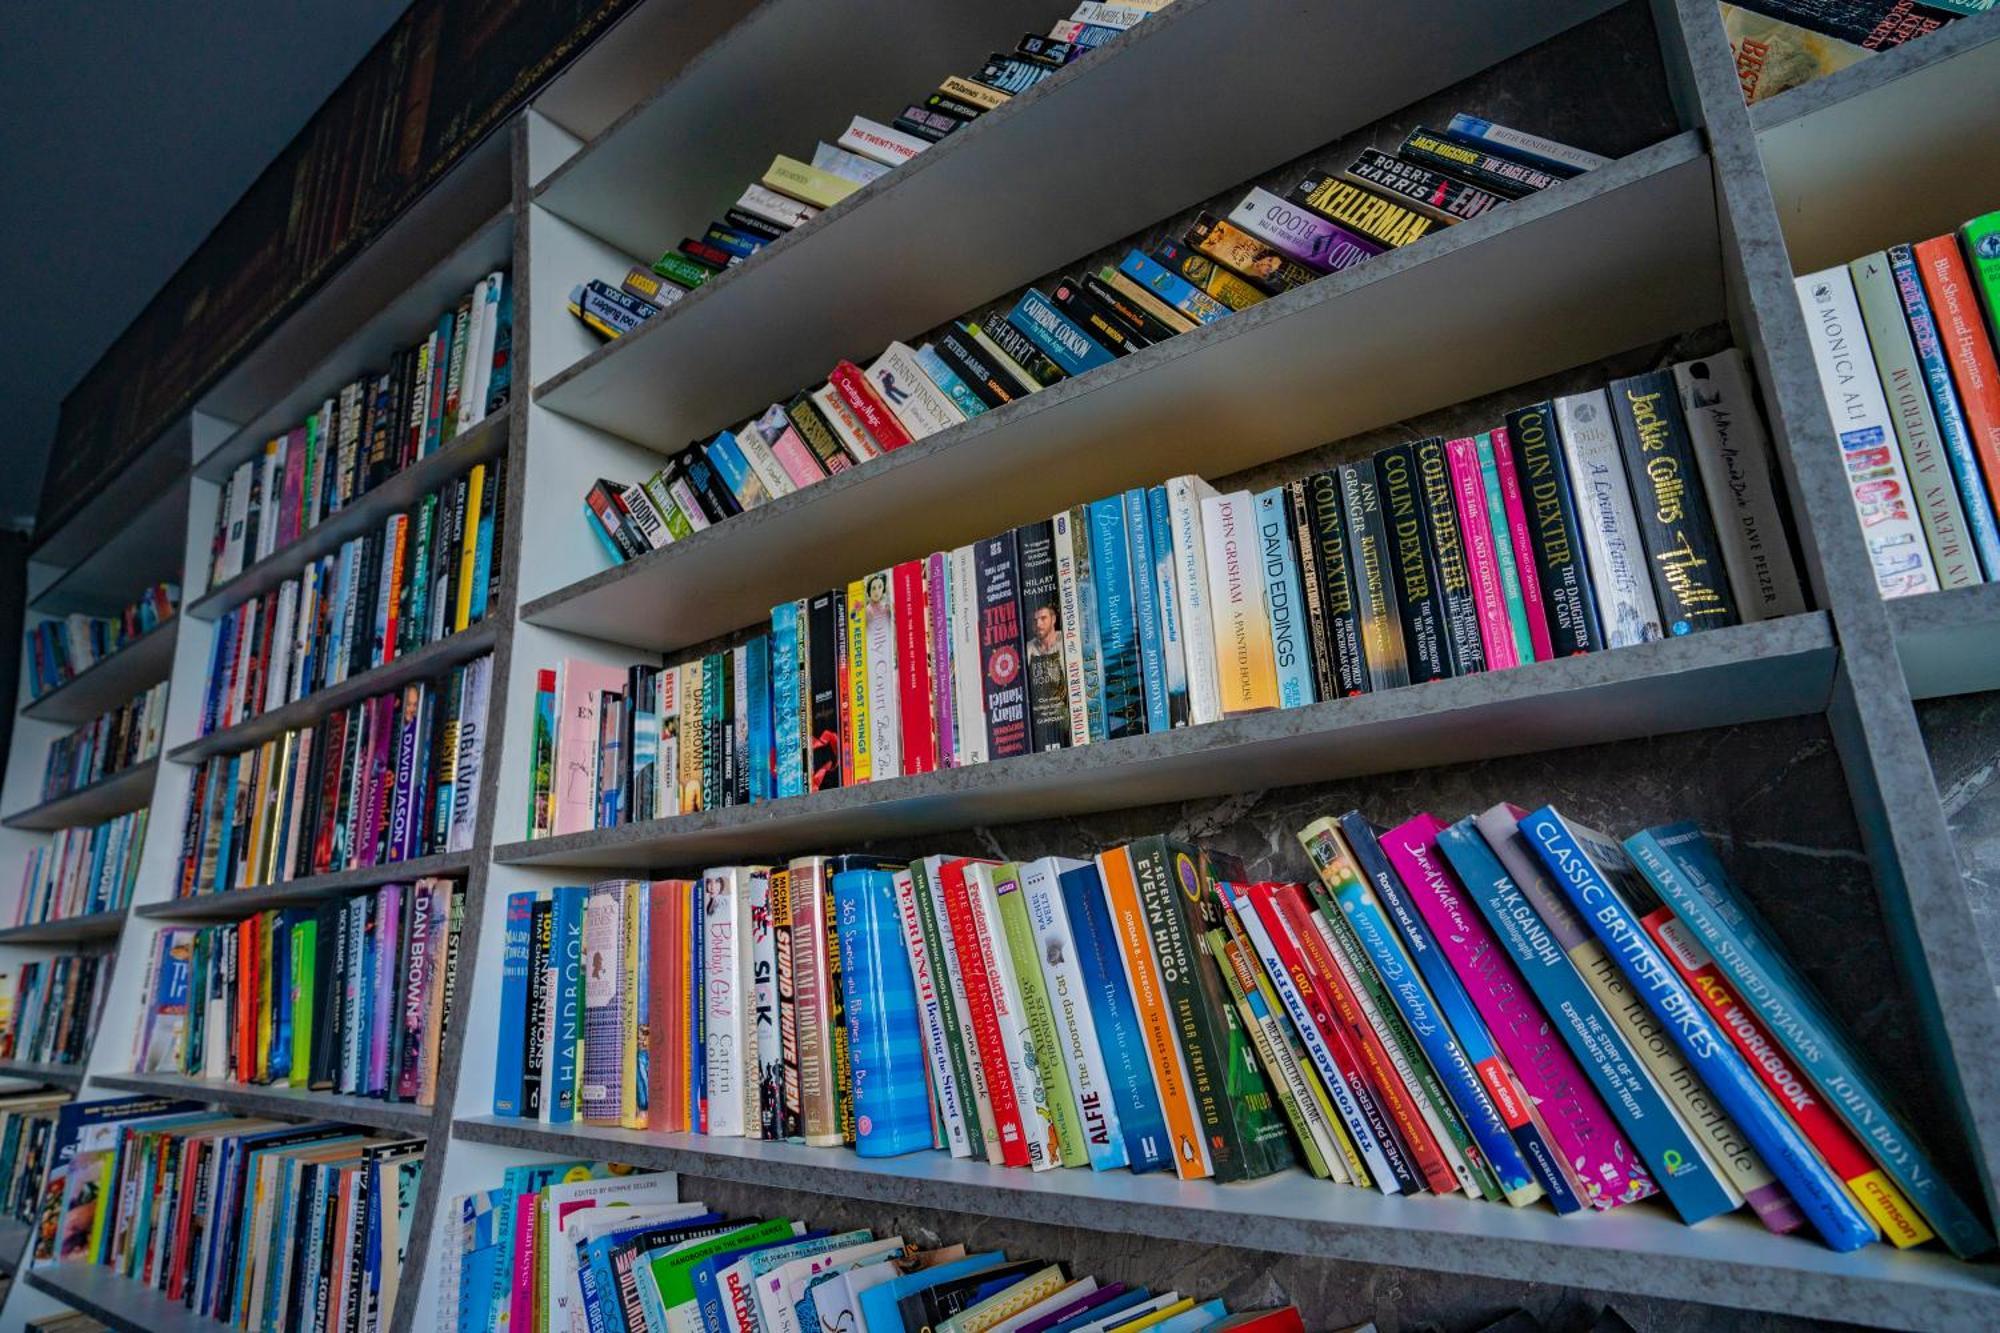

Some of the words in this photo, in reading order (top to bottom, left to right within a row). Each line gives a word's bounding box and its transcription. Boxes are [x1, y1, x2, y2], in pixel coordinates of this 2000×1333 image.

[1374, 155, 1430, 183] ROBERT
[1410, 136, 1437, 153] JACK
[1435, 142, 1480, 165] HIGGINS
[1481, 157, 1500, 172] THE
[1500, 160, 1530, 182] EAGLE
[1528, 170, 1550, 188] HAS
[1356, 164, 1430, 198] HARRIS
[1267, 205, 1318, 240] BLOOD
[1311, 180, 1433, 247] KELLERMAN
[1934, 258, 1948, 282] Blue
[1942, 284, 1958, 318] Shoes
[451, 309, 469, 343] DAN
[1021, 295, 1061, 333] CATHERINE
[1052, 321, 1092, 359] COOKSON
[1953, 318, 1967, 338] and
[443, 343, 465, 401] BROWN
[884, 351, 921, 390] PENNY
[941, 334, 969, 360] PETER
[962, 354, 991, 382] JAMES
[1820, 307, 1856, 384] MONICA
[1843, 391, 1867, 421] ALI
[1959, 335, 1985, 391] Happiness
[407, 382, 427, 428] RYAN
[1891, 367, 1937, 474] AMSTERDAM
[1419, 443, 1446, 510] COLIN
[1627, 389, 1666, 452] Jackie
[1647, 455, 1686, 524] Collins
[1314, 475, 1335, 535] COLIN
[1344, 468, 1365, 534] GRANGER
[1360, 482, 1377, 513] ANN
[1384, 455, 1415, 521] COLIN
[1518, 413, 1548, 477] COLIN
[1533, 480, 1572, 568] DEXTER
[625, 492, 665, 537] KOONTZ
[1218, 501, 1234, 538] JOHN
[1740, 514, 1763, 552] DAVE
[1262, 522, 1284, 577] DAVID
[1397, 521, 1430, 602] DEXTER
[1430, 509, 1466, 593] DEXTER
[1023, 584, 1057, 596] MANTEL
[1026, 575, 1054, 587] HILARY
[1323, 536, 1351, 616] DEXTER
[1476, 559, 1497, 609] FOREVER
[1552, 588, 1565, 600] OF
[1561, 564, 1574, 585] THE
[1750, 552, 1779, 604] PELZER
[1270, 581, 1295, 668] EDDINGS
[1556, 601, 1572, 629] CAIN
[1565, 586, 1590, 649] DAUGHTERS
[1427, 630, 1441, 674] THROUGH
[693, 688, 703, 713] DAN
[703, 663, 713, 714] JAMES
[693, 720, 703, 771] BROWN
[856, 711, 866, 754] THINGS
[398, 733, 413, 783] DAVID
[449, 721, 478, 826] OBLIVION
[703, 719, 713, 810] PATTERSON
[391, 787, 408, 843] JASON
[772, 878, 780, 925] MOORE
[778, 876, 788, 925] MICHAEL
[897, 877, 923, 938] PETER
[954, 881, 967, 902] THE
[967, 882, 989, 935] Freedom
[1376, 872, 1399, 907] Romeo
[1403, 840, 1434, 887] David
[1430, 882, 1471, 935] Walliams
[412, 896, 428, 938] DAN
[542, 912, 551, 949] 1001
[842, 899, 855, 926] 365
[1137, 859, 1162, 927] EVELYN
[1156, 931, 1178, 983] HUGO
[1154, 866, 1170, 907] SEVEN
[1165, 908, 1188, 975] HUSBANDS
[1394, 906, 1409, 923] and
[1400, 920, 1428, 953] Juliet
[776, 928, 792, 998] STUPID
[844, 928, 857, 973] Stories
[960, 913, 982, 968] FOREST
[1534, 820, 1606, 905] CLASSIC
[1595, 903, 1668, 994] BRITISH
[1658, 985, 1722, 1061] BIKES
[1637, 845, 1664, 872] THE
[1656, 867, 1685, 901] BOY
[1681, 894, 1701, 917] IN
[1696, 913, 1721, 942] THE
[1717, 939, 1771, 1006] STRIPED
[1760, 999, 1823, 1066] PYJAMAS
[405, 941, 424, 1017] BROWN
[532, 945, 542, 999] CHANGED
[909, 936, 937, 1001] LYNCH
[1053, 973, 1069, 996] Cat
[1264, 954, 1289, 987] FEW
[535, 951, 550, 1068] INVENTIONS
[560, 923, 581, 1081] HANDBOOK
[1102, 981, 1117, 1014] Those
[1177, 998, 1197, 1044] TAYLOR
[1281, 986, 1306, 1021] THE
[529, 1025, 537, 1068] WORLD
[780, 999, 798, 1064] WHITE
[922, 1000, 948, 1056] Beating
[976, 982, 1015, 1111] ENCHANTMENTS
[1059, 998, 1087, 1058] Doorstep
[1111, 1017, 1124, 1040] who
[1300, 1021, 1317, 1042] OF
[1585, 1013, 1603, 1033] THE
[1594, 1027, 1621, 1059] STORY
[1616, 1057, 1631, 1074] OF
[1624, 1070, 1643, 1092] MY
[1696, 973, 1734, 1009] ACT
[1723, 1006, 1816, 1113] WORKBOOK
[936, 1056, 950, 1074] the
[962, 1023, 978, 1058] anne
[970, 1059, 989, 1100] frank
[1074, 1062, 1092, 1088] The
[1117, 1042, 1131, 1064] are
[1186, 1047, 1209, 1098] JENKINS
[1559, 999, 1607, 1065] EXPERIMENTS
[1599, 1061, 1625, 1091] WITH
[1617, 1086, 1645, 1120] TRUTH
[1588, 956, 1625, 996] The
[1622, 997, 1676, 1064] Tudor
[1669, 1067, 1757, 1175] Interlude
[786, 1068, 800, 1114] MEN
[939, 1073, 961, 1119] Street
[1125, 1066, 1144, 1112] loved
[1307, 1042, 1358, 1117] COURAGE
[1343, 1069, 1390, 1139] PATTERSON
[1825, 1074, 1876, 1125] JOHN
[1080, 1090, 1110, 1147] ALFIE
[1202, 1096, 1218, 1125] REID
[1349, 1118, 1375, 1153] THE
[1380, 1138, 1412, 1182] JAMES
[504, 1170, 515, 1182] IT
[574, 1188, 597, 1197] EDITED
[1528, 1140, 1566, 1196] CAMBRIDGE
[496, 1187, 514, 1236] STARTS
[1863, 1179, 1919, 1240] crimson
[493, 1240, 507, 1276] WITH
[518, 1249, 532, 1287] keyes
[490, 1281, 502, 1300] US
[579, 1268, 599, 1299] NORA
